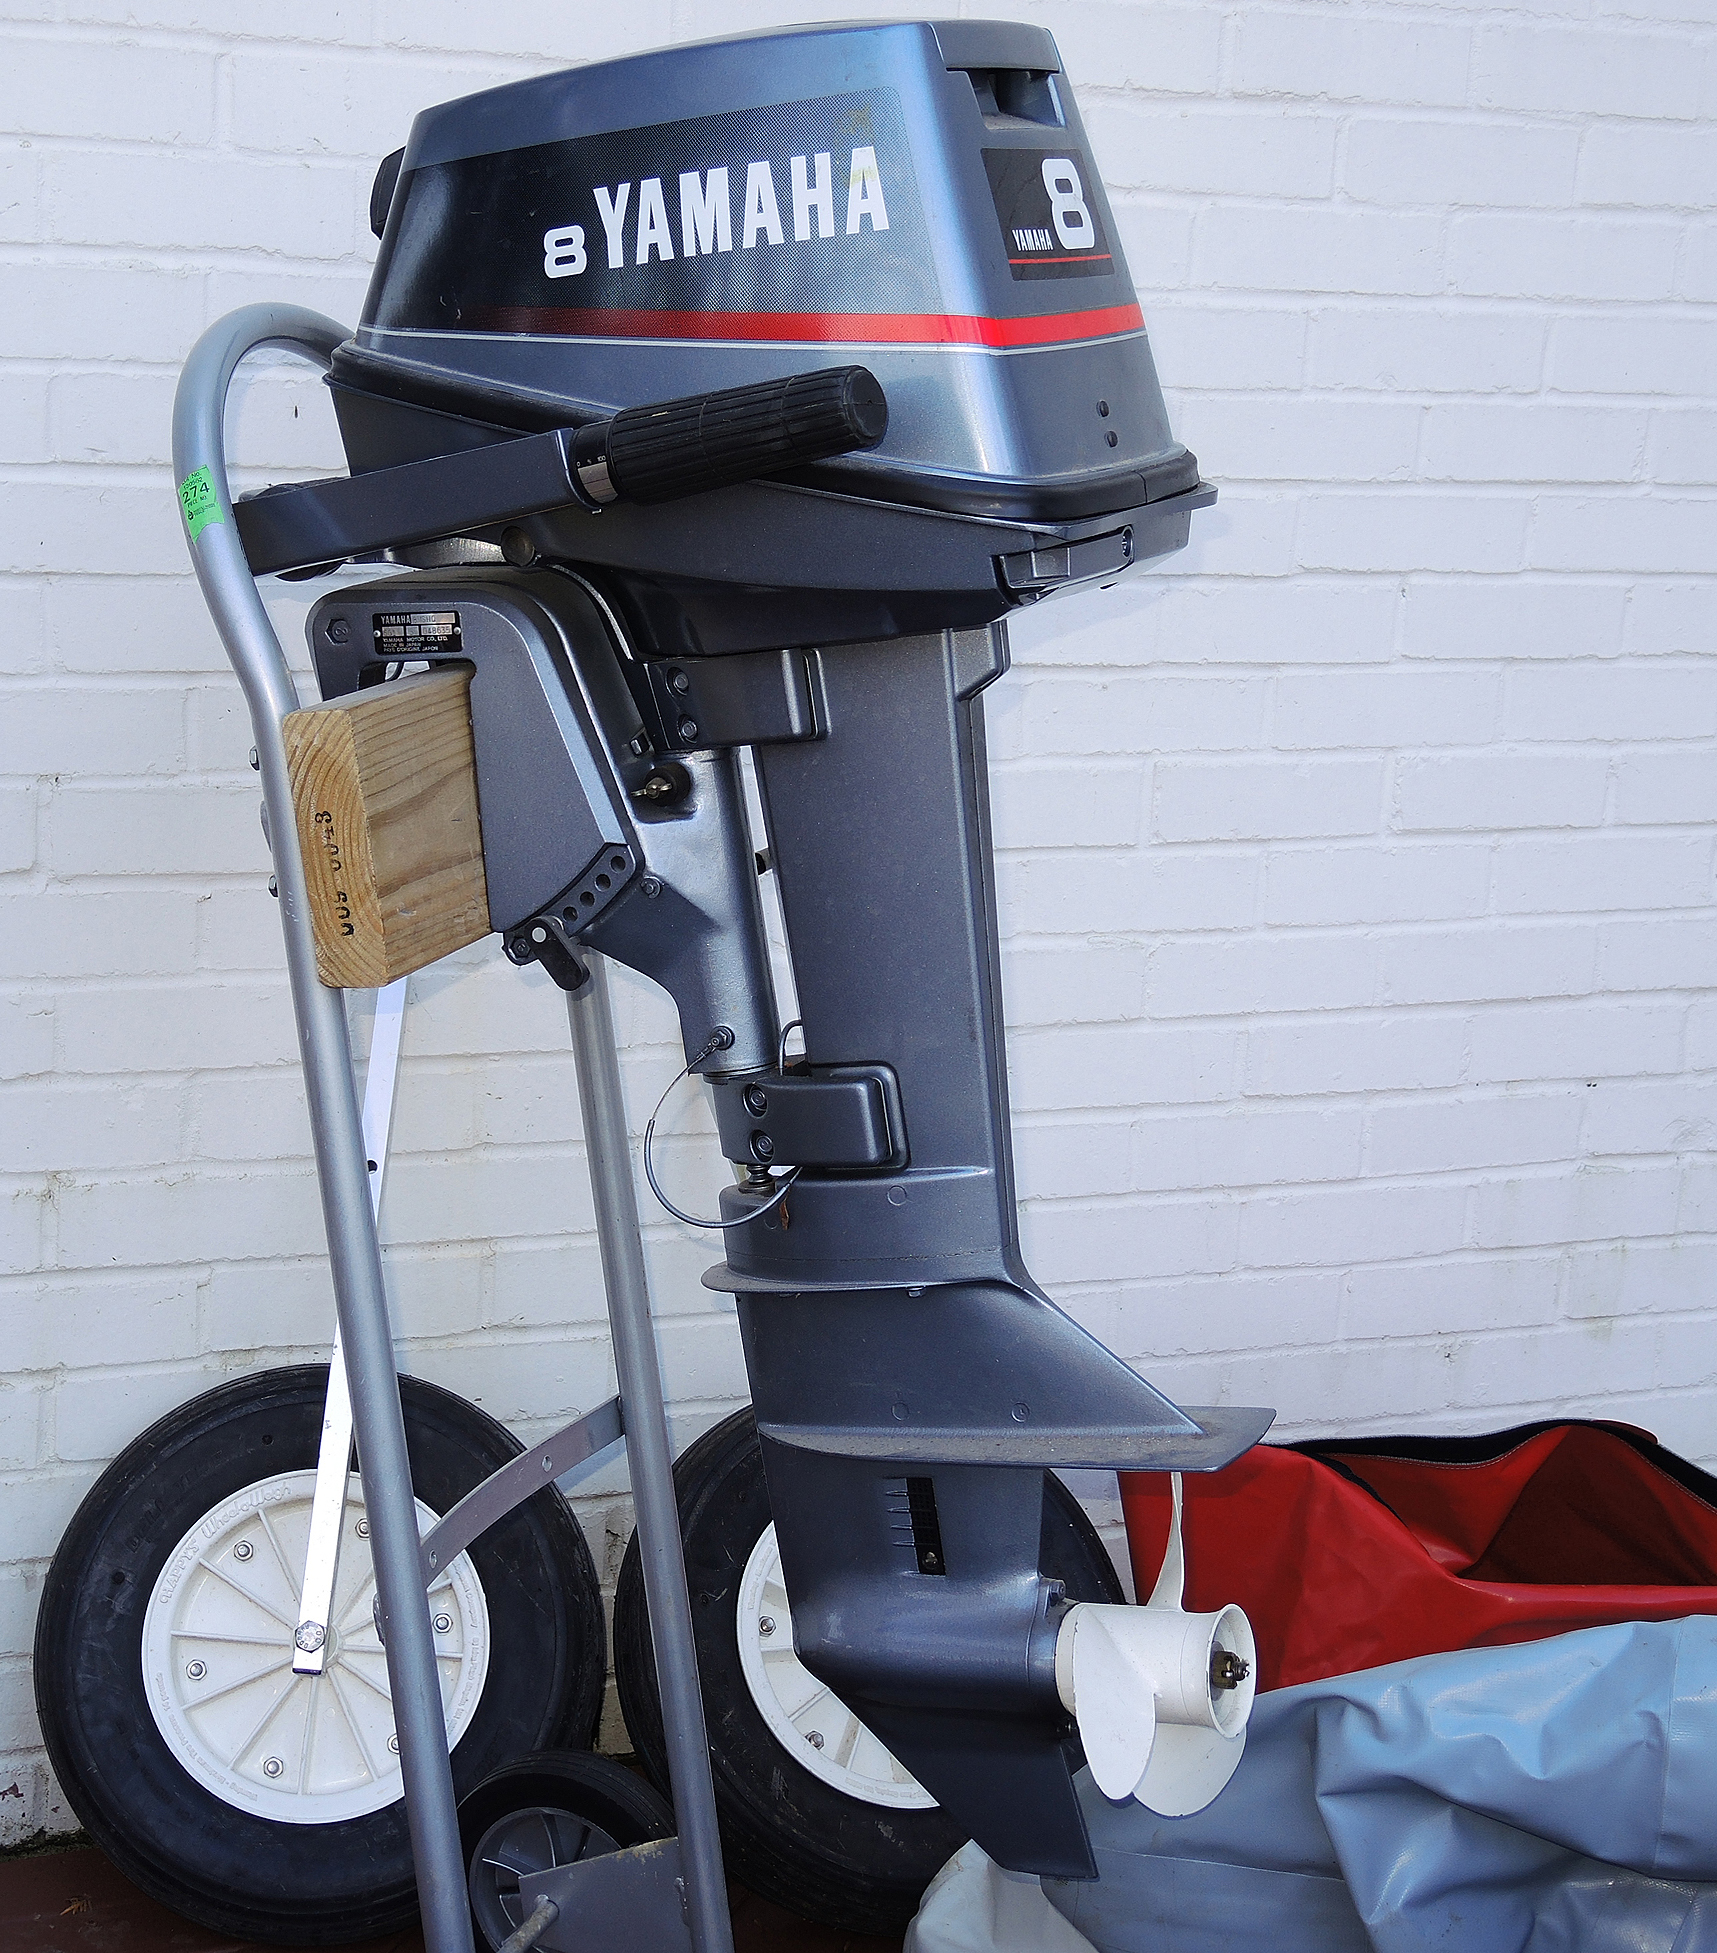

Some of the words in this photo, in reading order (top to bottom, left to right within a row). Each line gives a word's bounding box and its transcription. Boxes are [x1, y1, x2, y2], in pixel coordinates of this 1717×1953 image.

[543, 225, 587, 279] 8
[593, 145, 890, 269] YAMAHA
[1041, 158, 1095, 250] 8
[1011, 229, 1054, 251] YAMAHA
[182, 481, 210, 504] 274
[381, 615, 411, 624] YAMAHA
